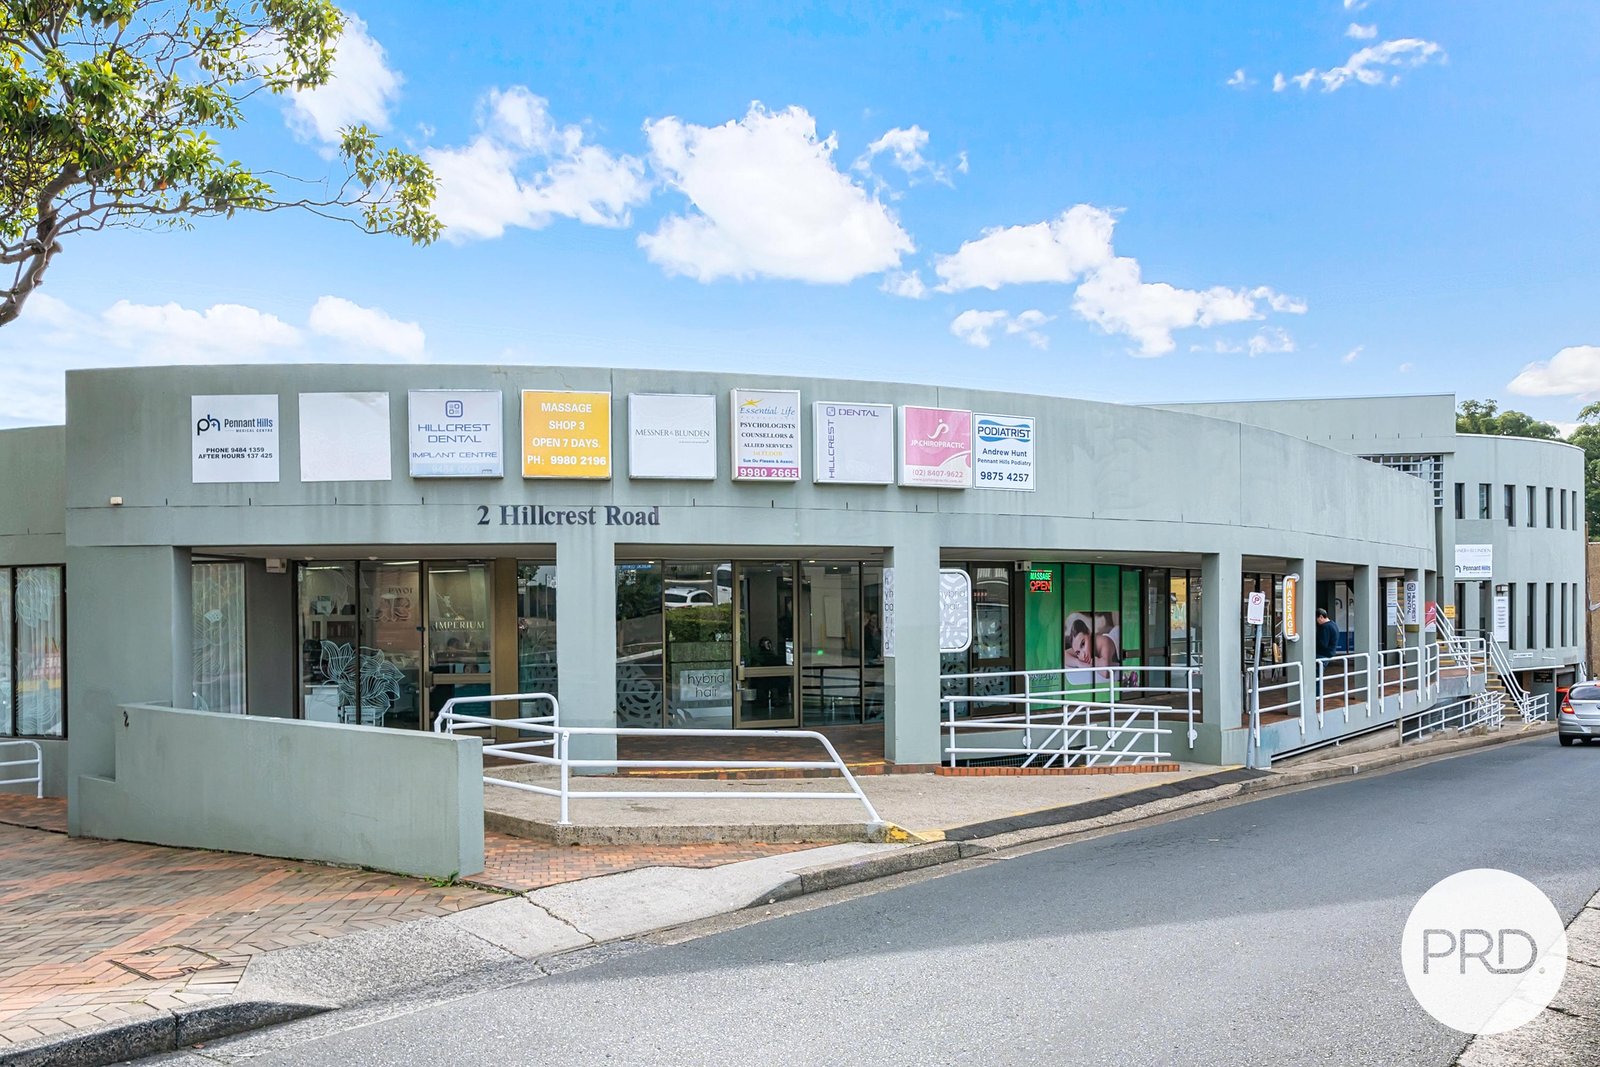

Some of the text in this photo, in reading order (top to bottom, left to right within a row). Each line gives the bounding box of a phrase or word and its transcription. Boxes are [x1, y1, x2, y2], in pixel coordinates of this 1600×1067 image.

[541, 402, 592, 413] MASSAGE
[740, 406, 795, 417] Essential Life
[838, 408, 879, 418] DENTAL
[224, 418, 273, 428] Pennant Hills
[417, 423, 491, 432] HILLCREST
[548, 421, 585, 430] SHOP 3
[977, 426, 1031, 438] PODIATRIST
[427, 435, 482, 443] DENTAL
[532, 438, 561, 447] OPEN
[562, 438, 569, 447] 7
[828, 419, 836, 479] HILLCREST
[982, 448, 1027, 457] Andrew Hunt
[550, 456, 577, 465] 9980
[580, 456, 606, 465] 2196
[1010, 459, 1031, 467] Podiatry
[740, 468, 798, 477] 9980 2665
[927, 470, 963, 478] 8407-9622
[980, 471, 1029, 482] 9875 4257
[477, 504, 660, 526] 2 Hillcrest Road
[1030, 572, 1052, 580] MASSAGE
[1030, 580, 1051, 590] OPEN
[434, 621, 485, 629] IMPERIUM
[687, 672, 725, 686] hybrid
[695, 686, 717, 698] hair
